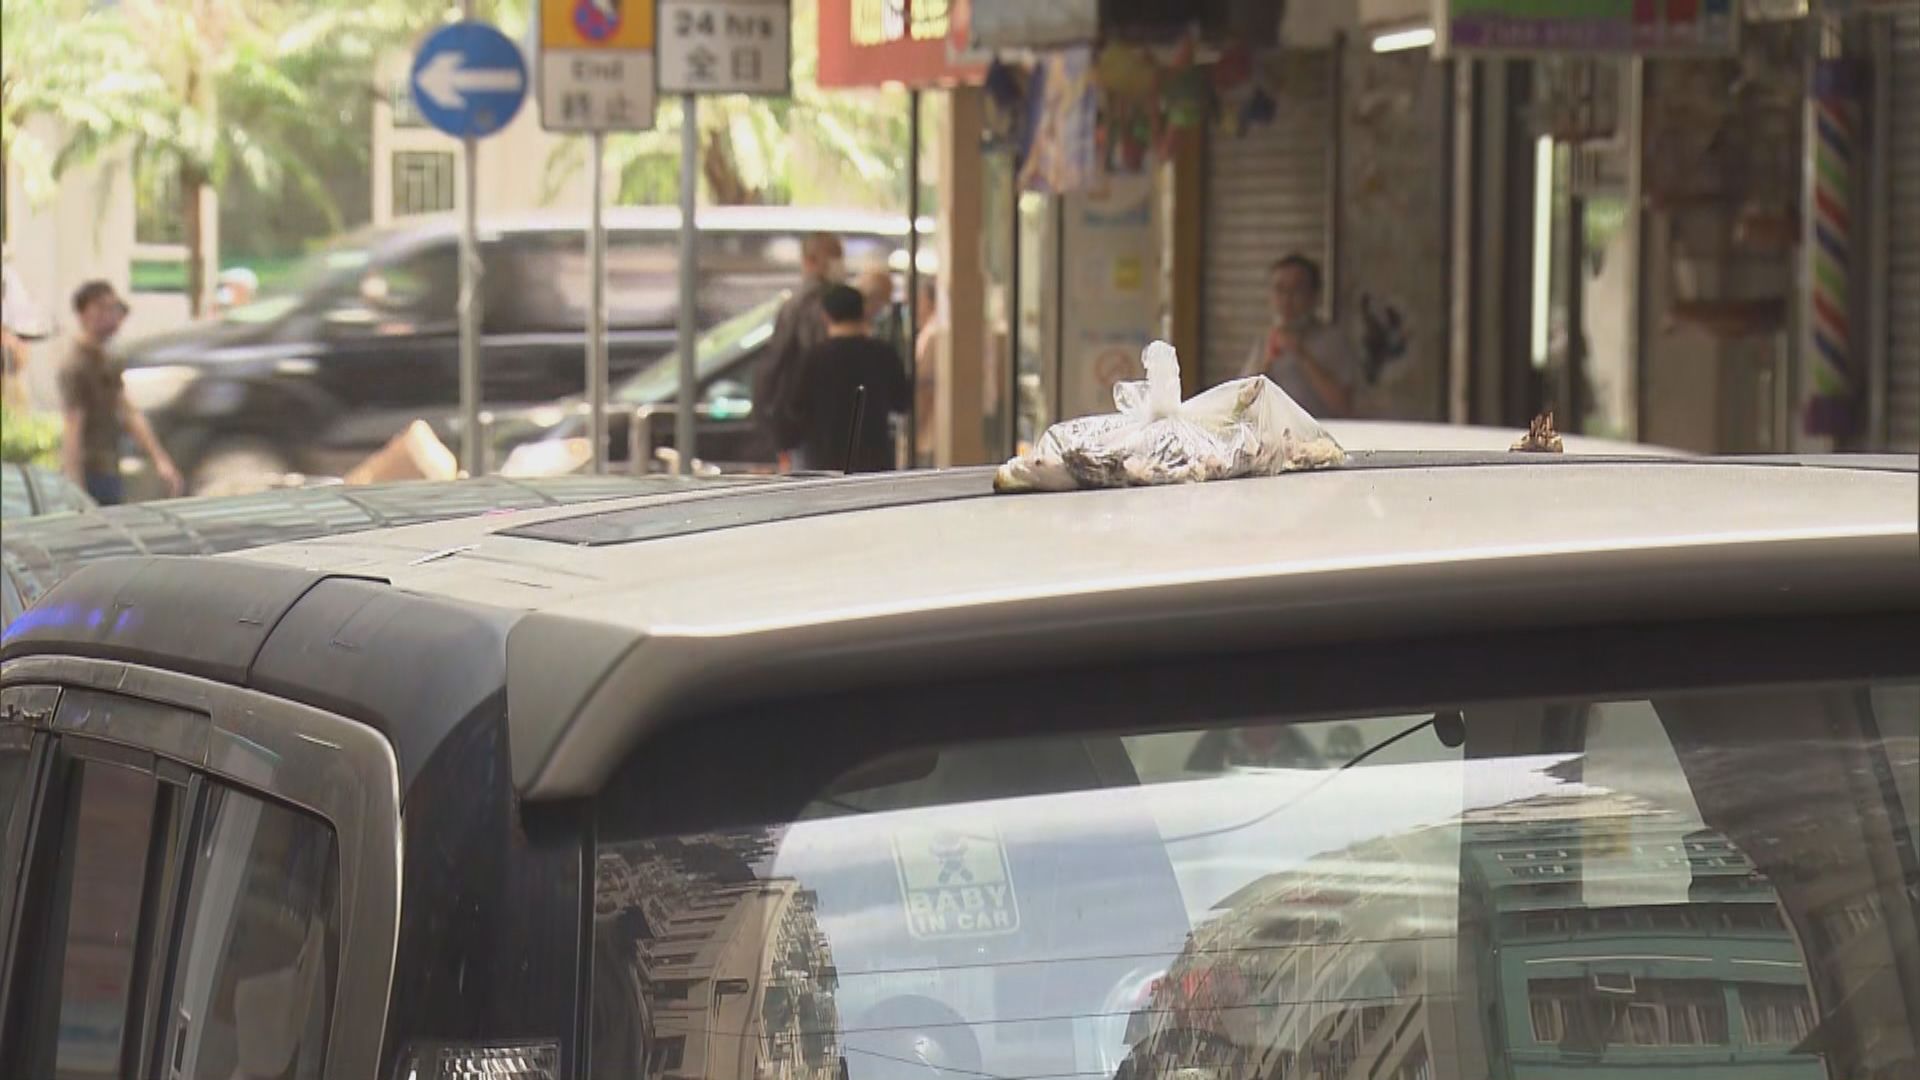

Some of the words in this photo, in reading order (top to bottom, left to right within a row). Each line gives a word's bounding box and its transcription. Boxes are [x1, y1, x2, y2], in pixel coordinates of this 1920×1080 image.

[675, 11, 714, 37] 24
[725, 11, 773, 37] hrs
[572, 60, 624, 82] End
[686, 46, 761, 82] 全日
[909, 885, 1007, 914] BABY
[916, 913, 946, 934] IN
[958, 910, 1009, 931] CAR
